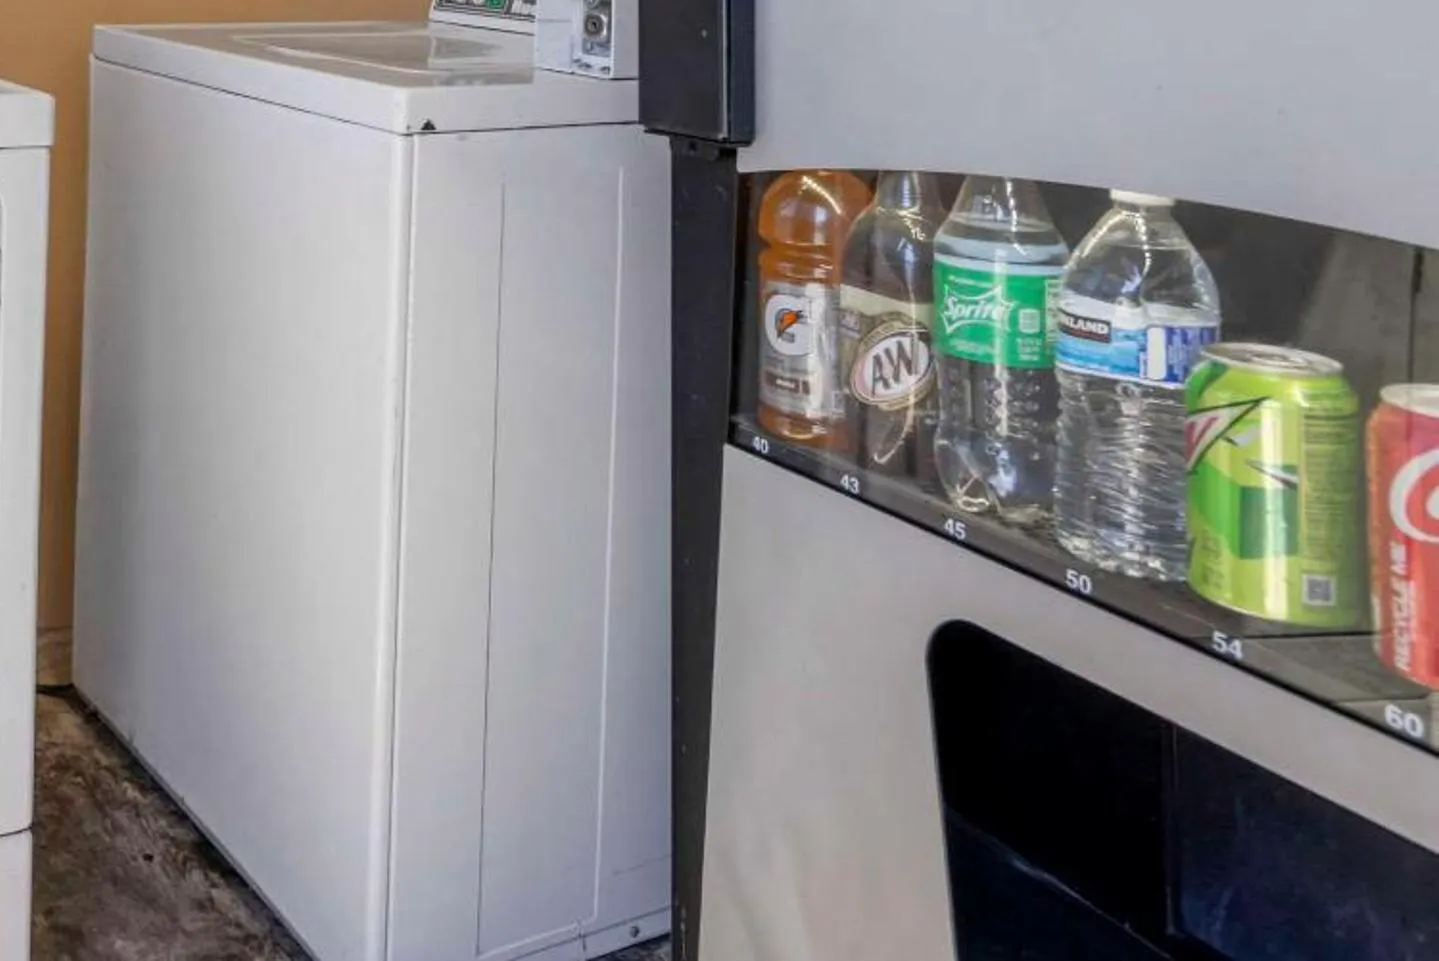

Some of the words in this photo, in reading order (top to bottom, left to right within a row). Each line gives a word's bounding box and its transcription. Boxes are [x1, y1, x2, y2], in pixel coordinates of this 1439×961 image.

[752, 436, 769, 454] 40
[840, 473, 860, 494] 43
[943, 518, 967, 540] 45
[1064, 568, 1093, 594] 50
[1211, 630, 1244, 660] 54
[1384, 703, 1425, 739] 60
